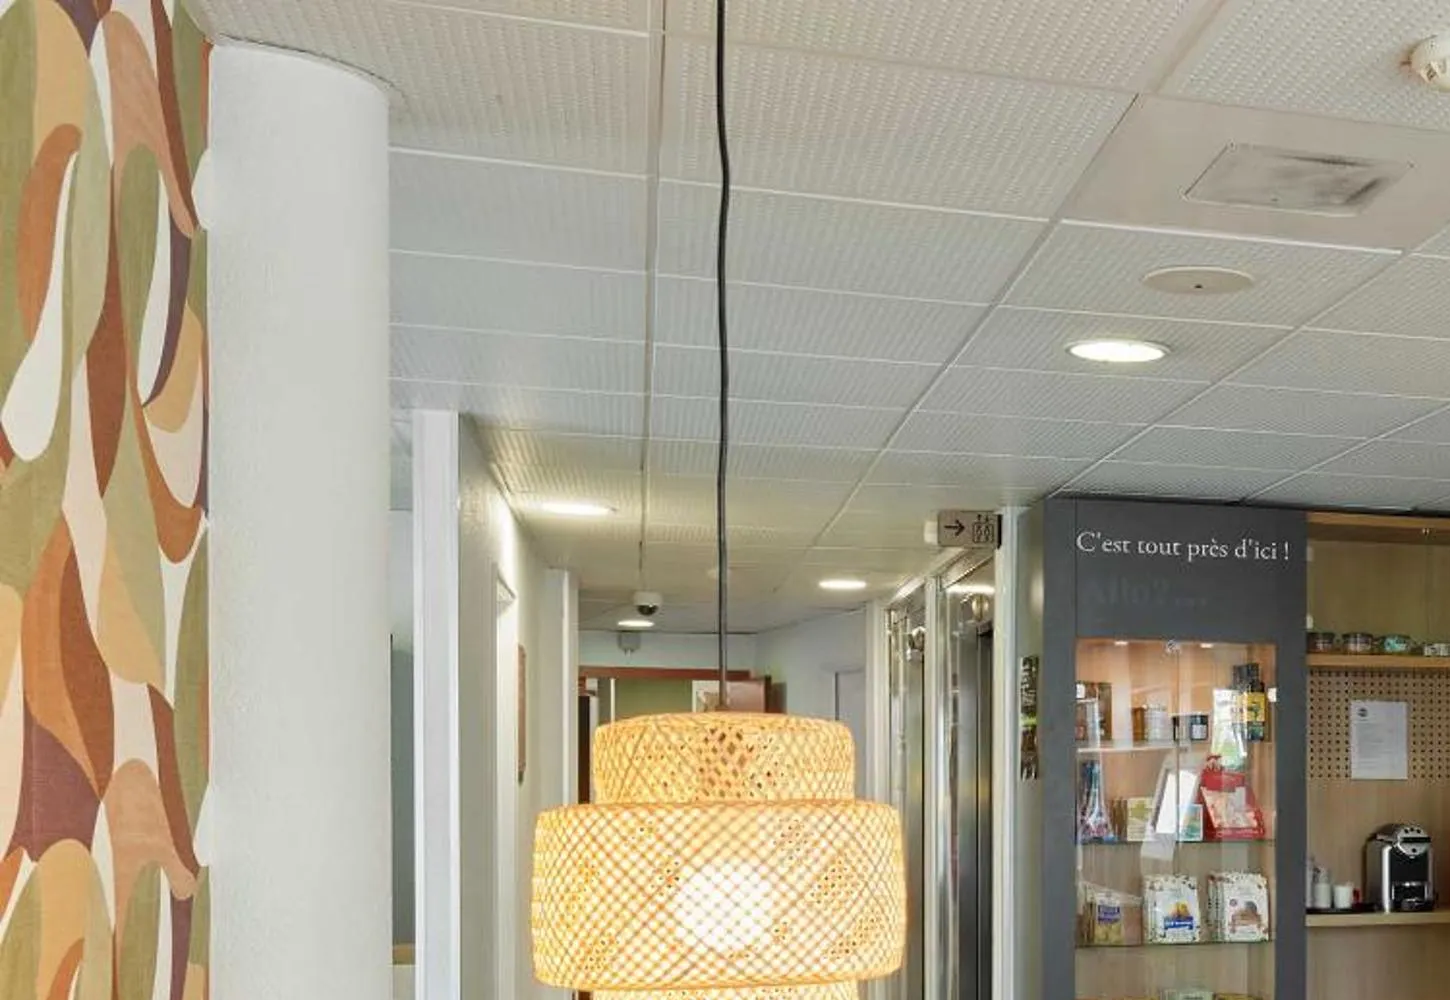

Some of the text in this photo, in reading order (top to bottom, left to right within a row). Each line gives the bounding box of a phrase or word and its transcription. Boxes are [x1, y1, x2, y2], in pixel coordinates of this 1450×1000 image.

[1076, 531, 1289, 562] C'est tout près d'ici !
